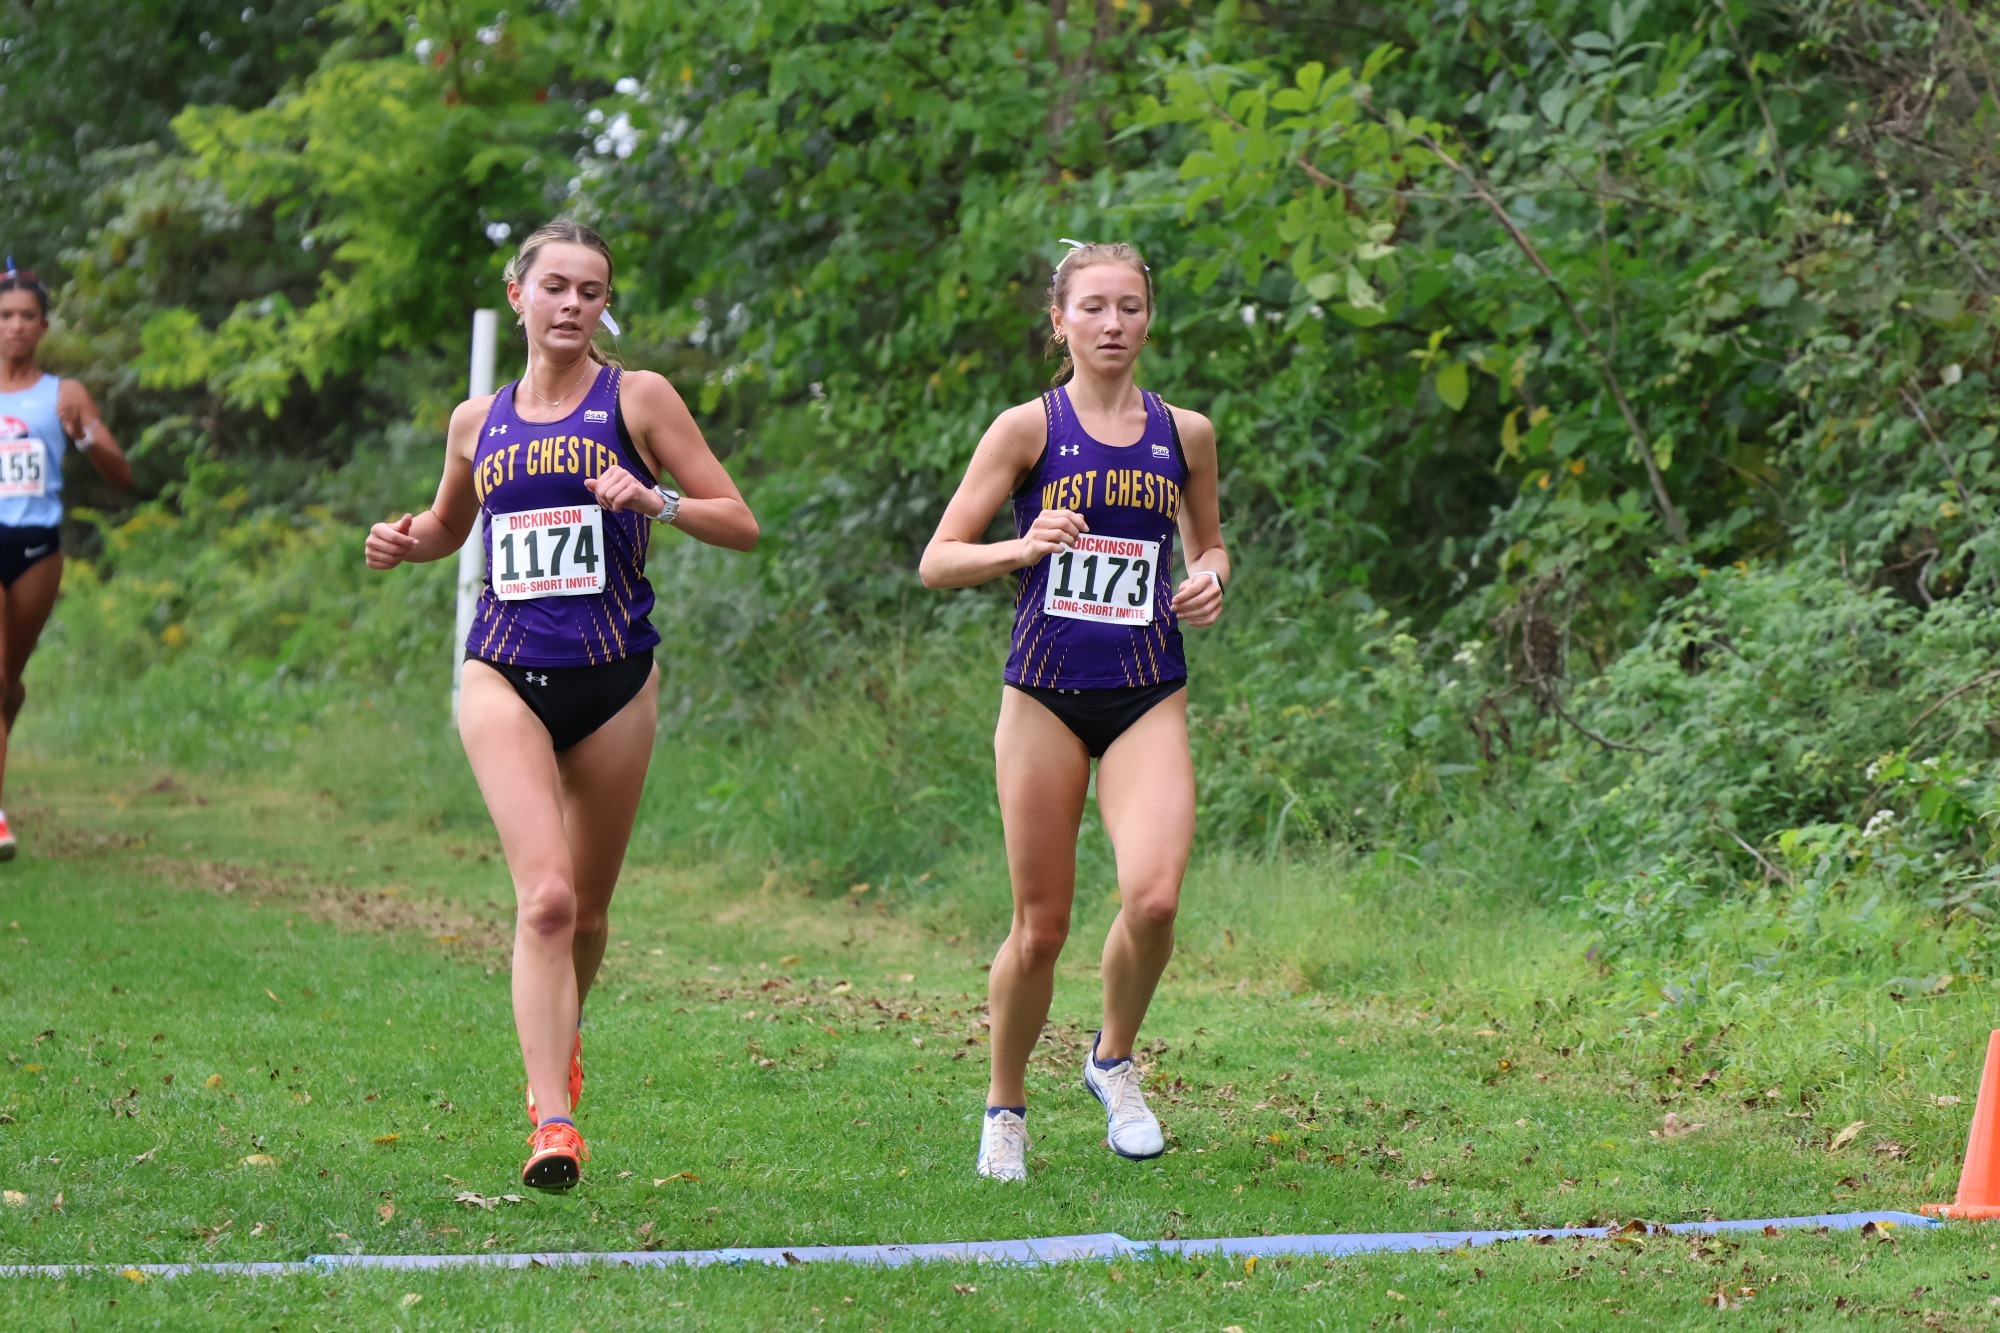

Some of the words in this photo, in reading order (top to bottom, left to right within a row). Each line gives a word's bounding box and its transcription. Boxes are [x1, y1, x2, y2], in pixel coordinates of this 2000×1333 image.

[474, 443, 520, 506] WEST
[1042, 470, 1097, 511] WEST
[1105, 469, 1180, 524] CHESTER
[509, 509, 582, 530] DICKINSON
[500, 525, 599, 581] 1174
[1072, 537, 1143, 557] DICKINSON
[500, 579, 563, 594] LONG-SHORT
[566, 576, 598, 588] INVITE
[1053, 551, 1150, 607] 1173
[1052, 599, 1113, 617] LONG-SHORT
[1115, 606, 1146, 619] INVITE
